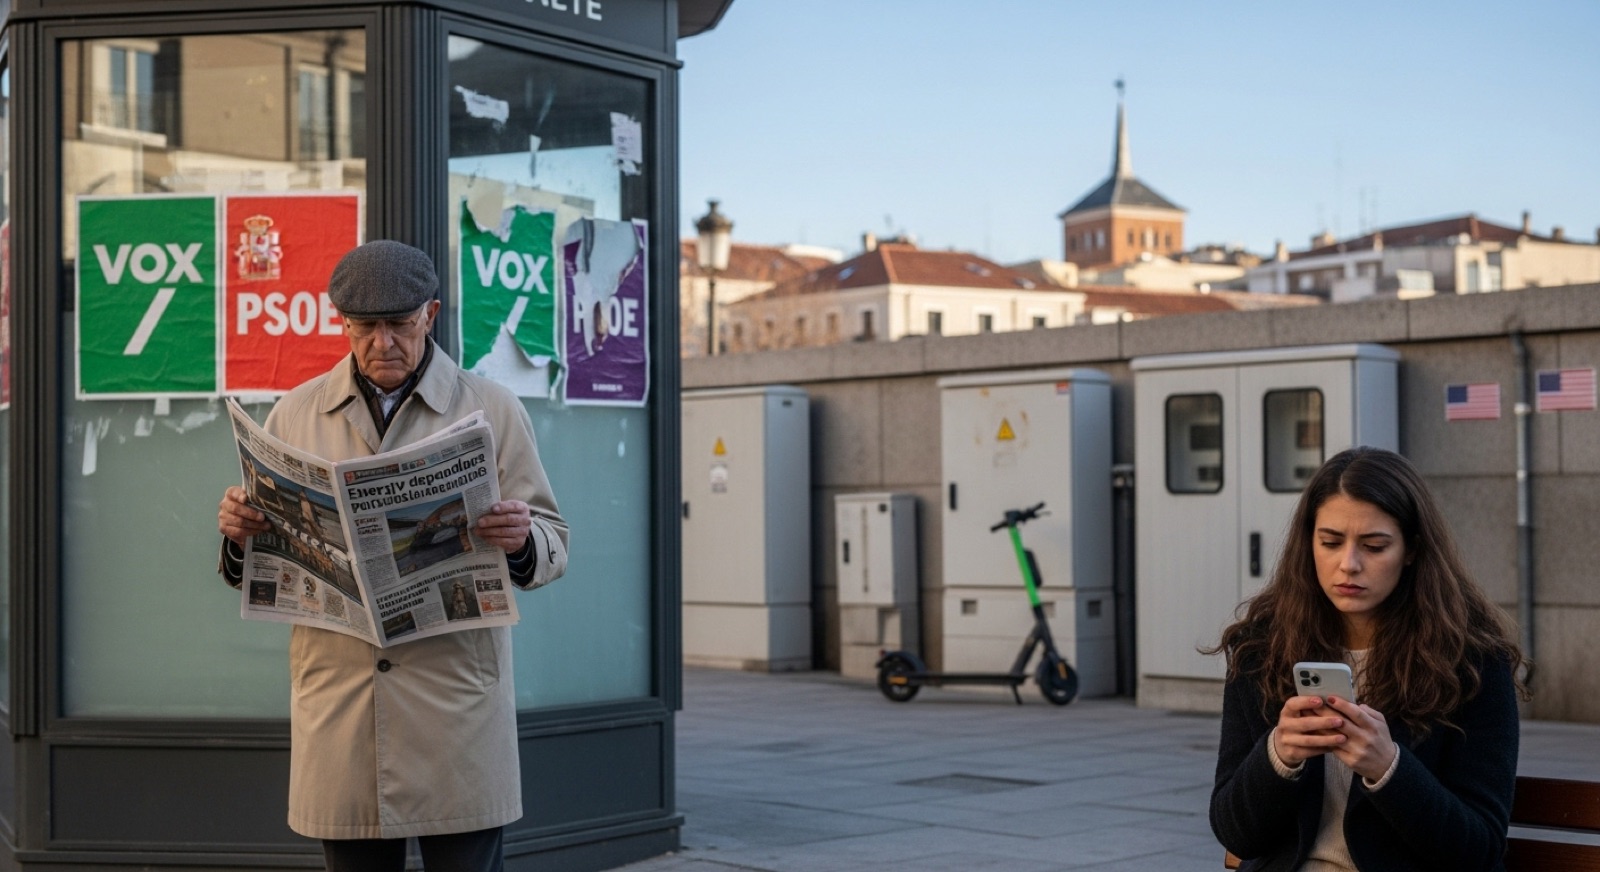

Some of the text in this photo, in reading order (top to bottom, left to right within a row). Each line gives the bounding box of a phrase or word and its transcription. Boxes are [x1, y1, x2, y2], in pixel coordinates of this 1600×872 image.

[92, 243, 204, 285] VOX
[471, 244, 550, 295] VOX
[236, 290, 343, 336] PSOE
